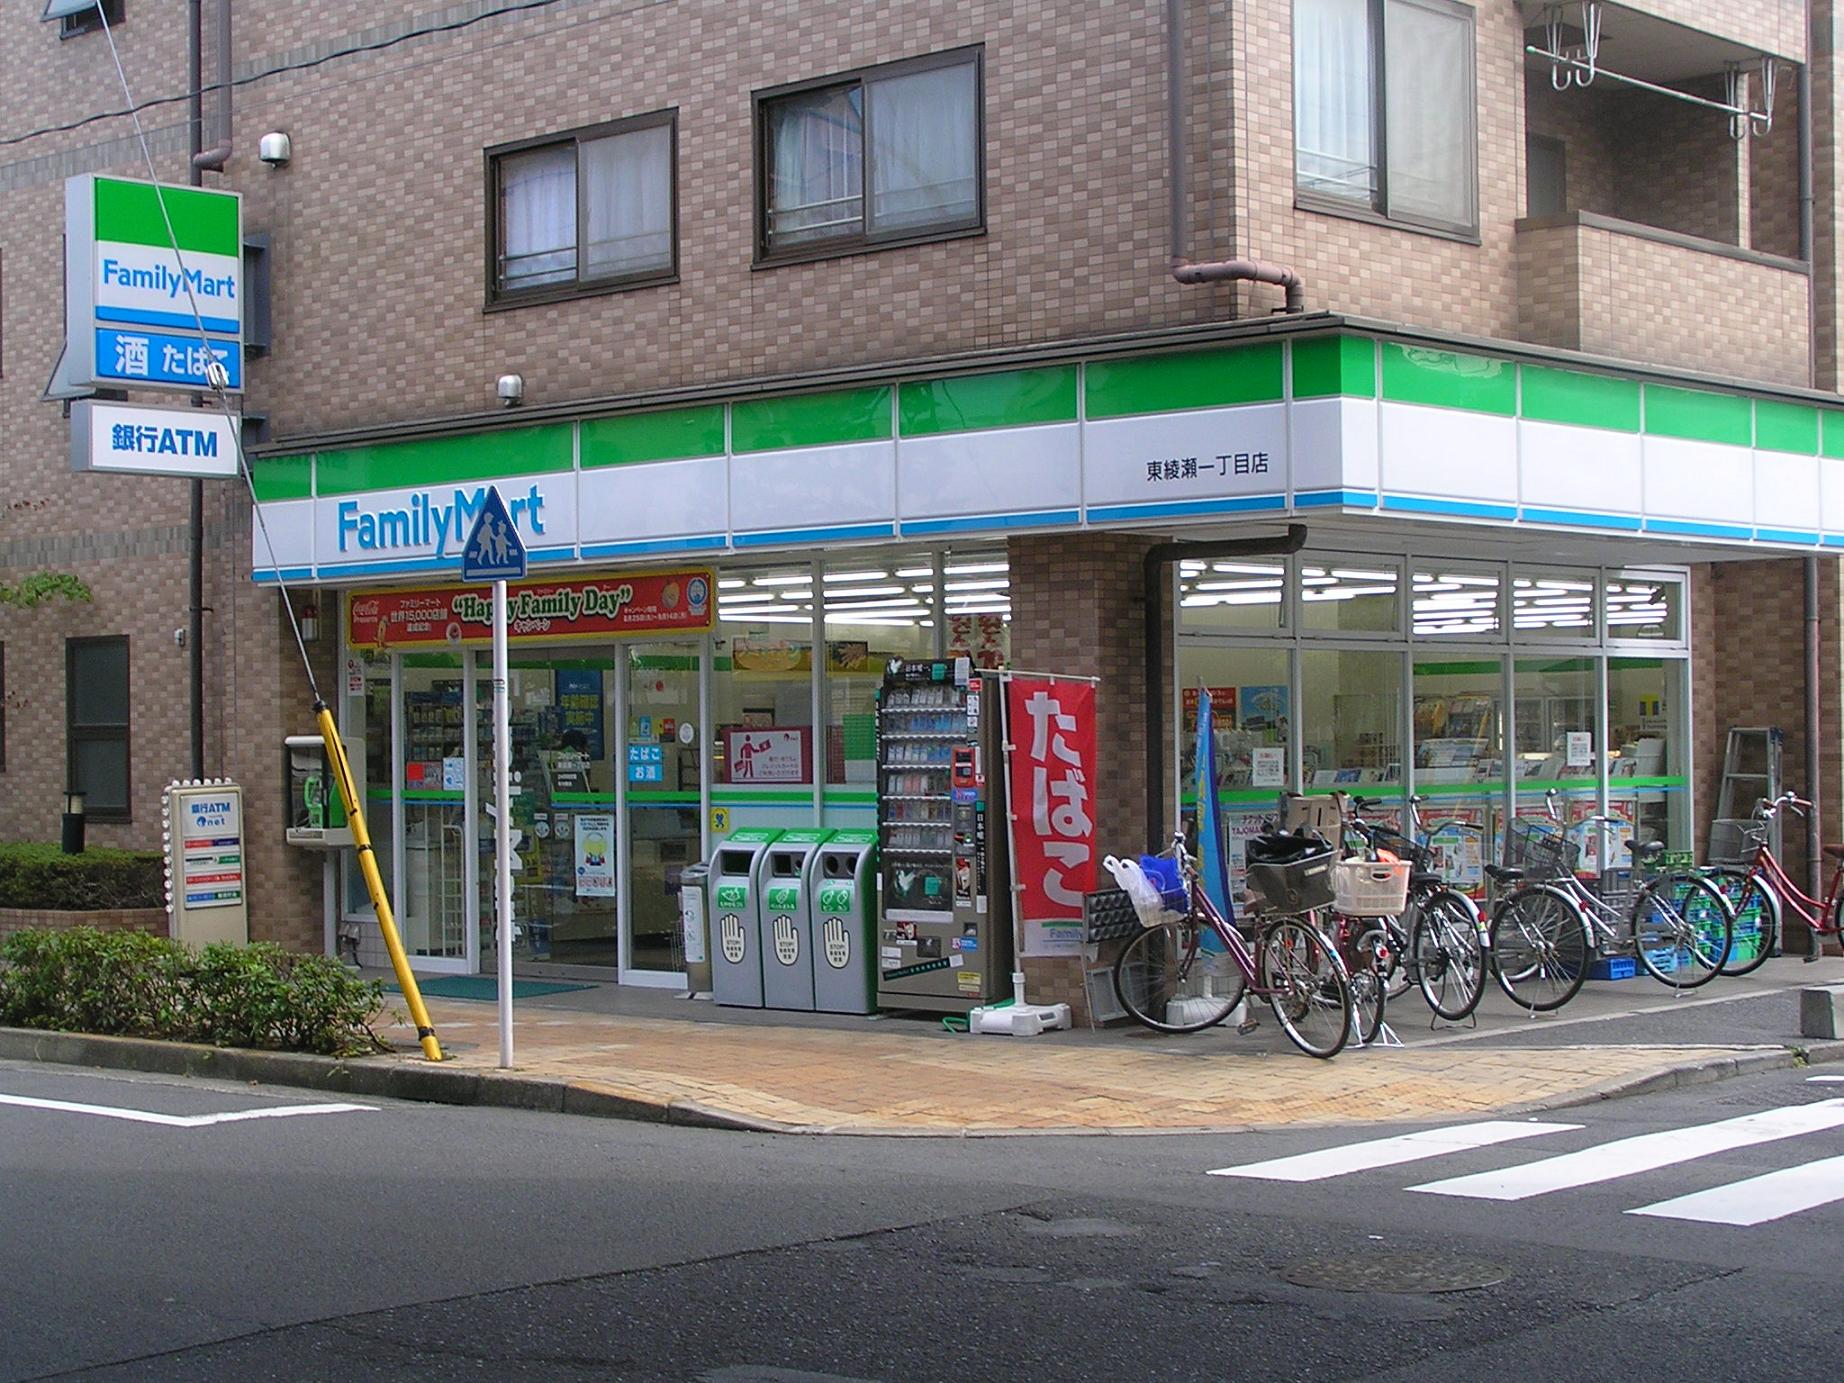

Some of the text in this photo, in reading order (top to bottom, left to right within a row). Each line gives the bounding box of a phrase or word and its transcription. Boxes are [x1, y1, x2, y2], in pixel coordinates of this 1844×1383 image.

[103, 258, 235, 299] FamilyMart
[115, 334, 149, 376] 酒
[112, 423, 218, 457] 銀行ATM
[1146, 452, 1269, 482] 東綾瀬一丁目店
[337, 484, 546, 559] FamilyMrt
[518, 588, 581, 620] Family
[628, 746, 661, 761] たばこ
[635, 765, 657, 779] お酒
[191, 802, 231, 814] 銀行ATM
[1024, 690, 1094, 908] たばこ
